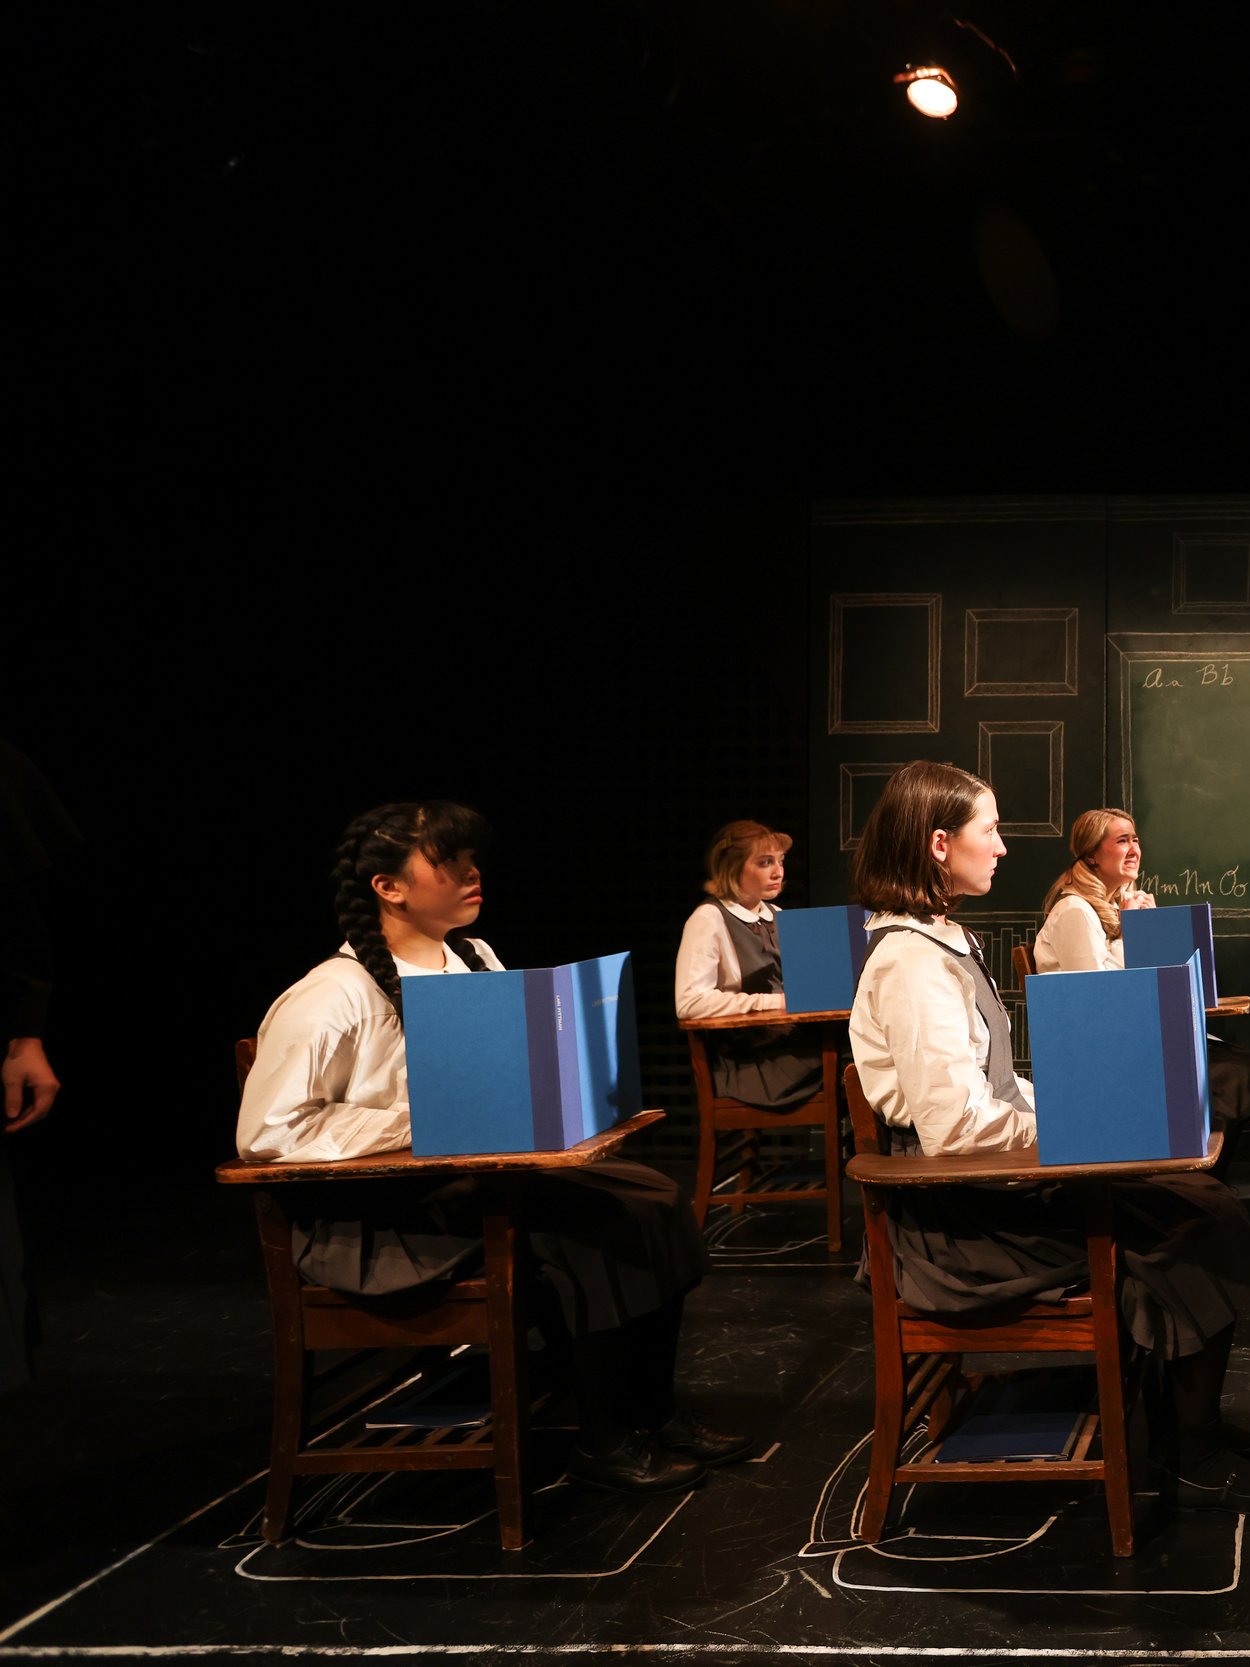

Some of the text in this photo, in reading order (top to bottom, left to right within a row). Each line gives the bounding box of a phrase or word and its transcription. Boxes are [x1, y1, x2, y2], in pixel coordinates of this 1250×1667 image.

[1142, 668, 1184, 688] Aa
[1195, 663, 1235, 687] Bb
[1178, 868, 1214, 897] Nn
[1219, 864, 1249, 898] Oo
